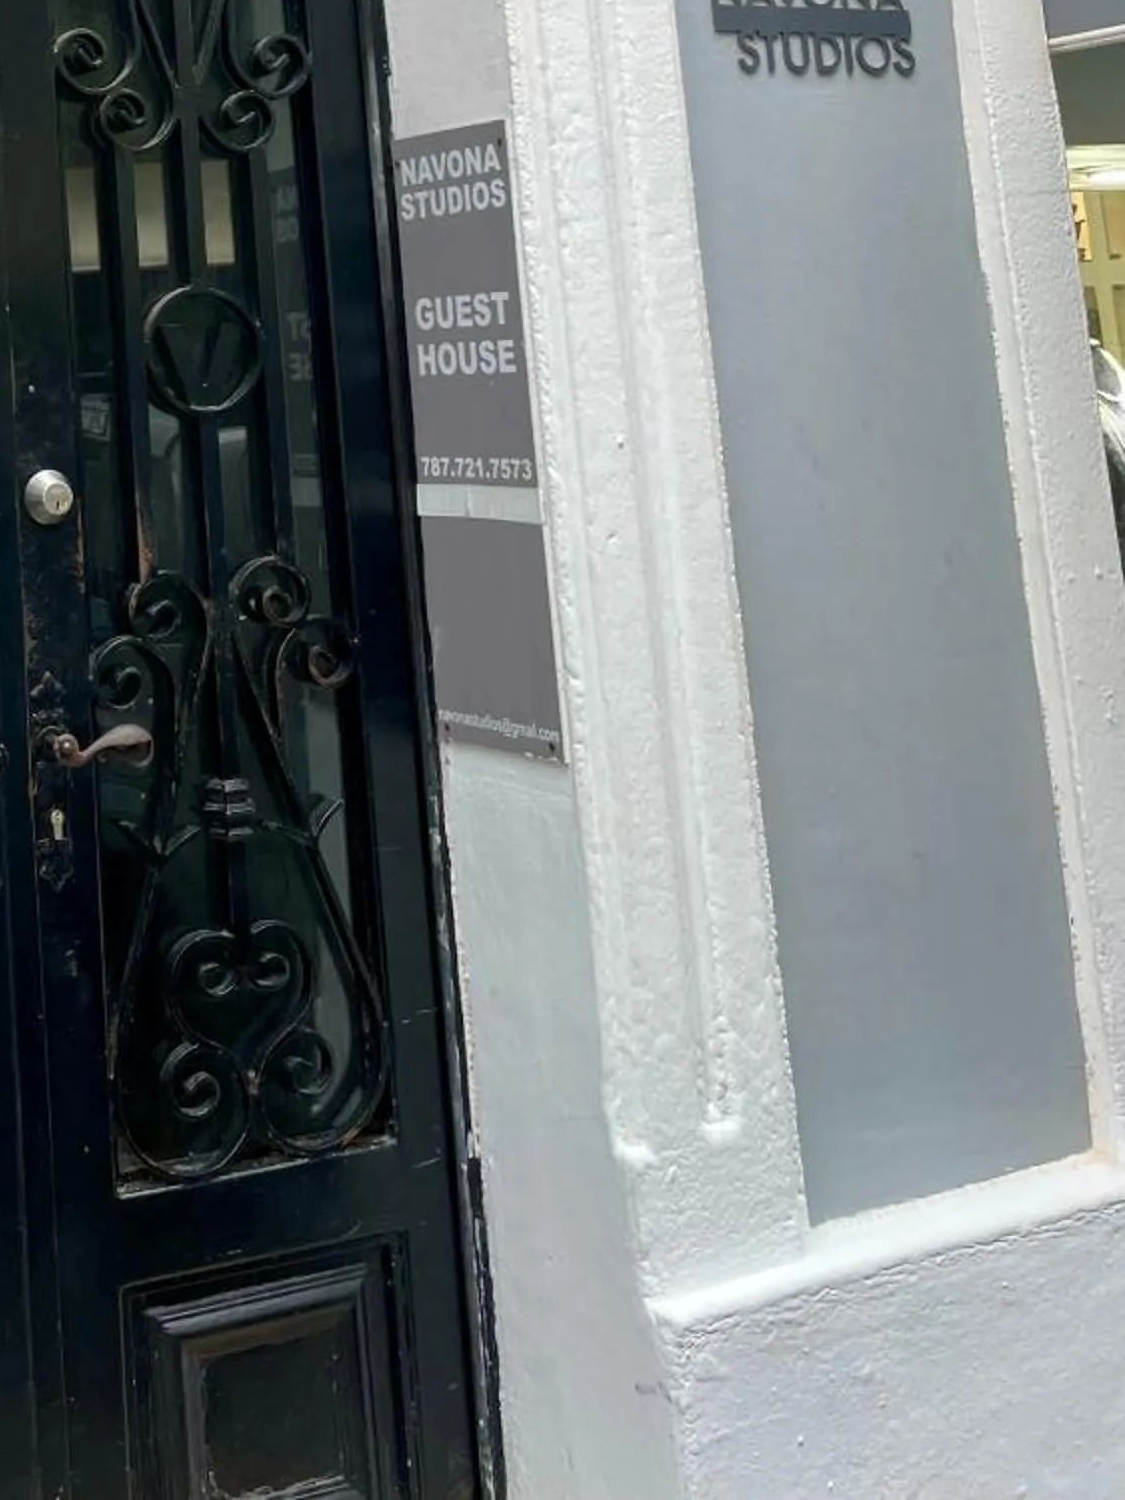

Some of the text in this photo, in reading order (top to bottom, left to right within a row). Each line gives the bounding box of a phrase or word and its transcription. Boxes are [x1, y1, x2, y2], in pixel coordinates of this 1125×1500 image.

[735, 29, 916, 79] STUDIOS
[400, 143, 502, 187] NAVONA
[400, 178, 507, 221] STUDIOS
[414, 291, 509, 331] GUEST
[416, 339, 518, 377] HOUSE
[420, 456, 533, 481] 787.721.7573
